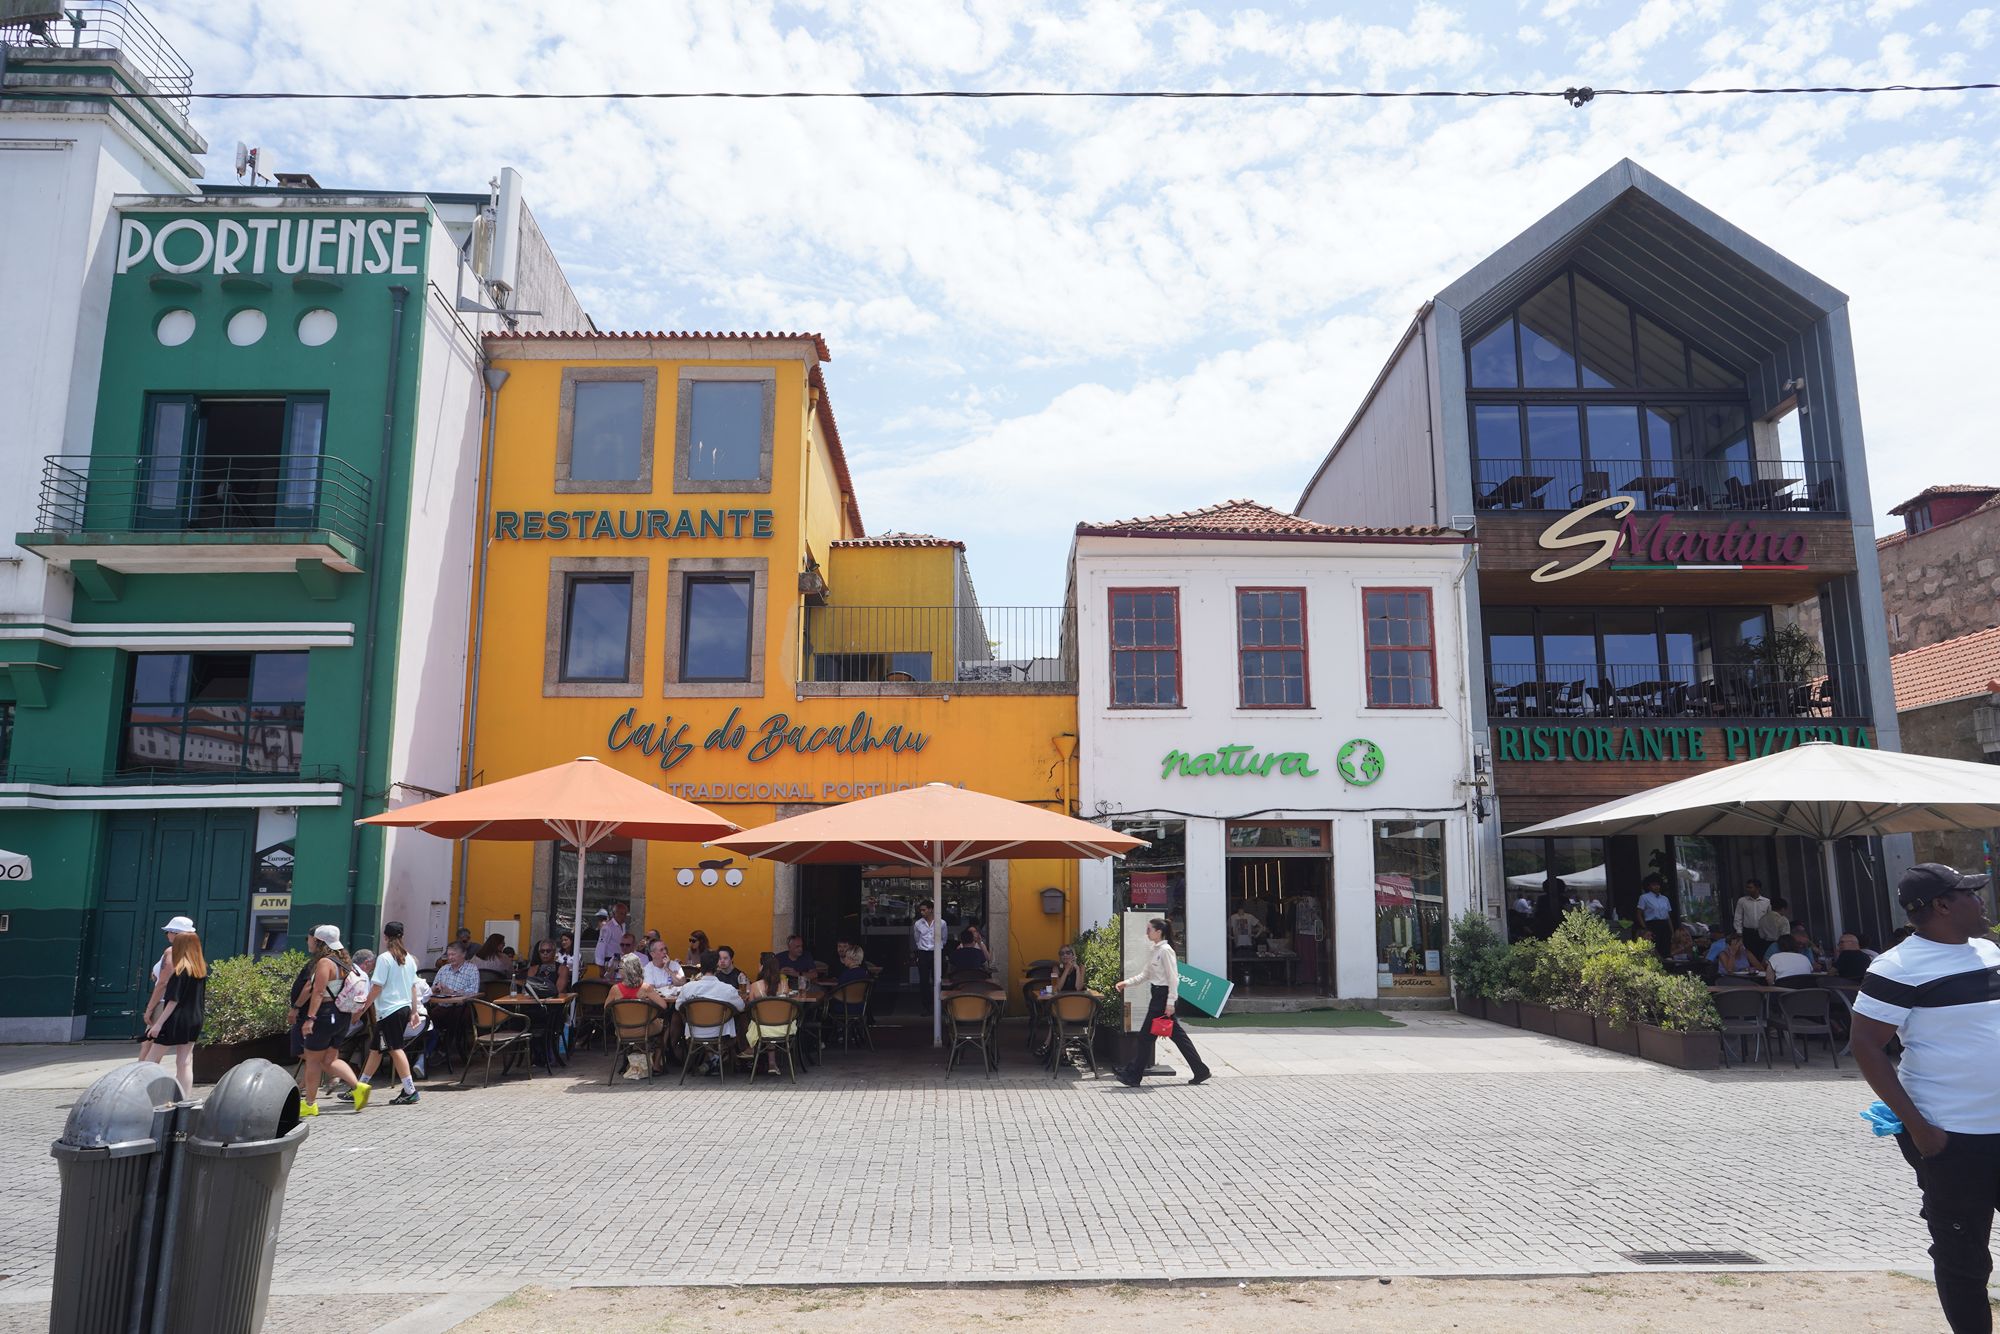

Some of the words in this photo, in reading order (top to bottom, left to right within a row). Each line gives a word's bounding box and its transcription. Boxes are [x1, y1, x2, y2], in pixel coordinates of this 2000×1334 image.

[116, 219, 421, 275] PORTUENSE
[495, 509, 774, 540] RESTAURANTE
[1611, 513, 1809, 563] Martino
[607, 706, 695, 770] Cais
[703, 706, 747, 751] do
[747, 711, 930, 763] Bacalhau
[1498, 726, 1706, 762] RISTORANTE
[1161, 743, 1319, 780] natura
[669, 783, 815, 799] TRADICIONAL
[260, 899, 287, 907] ATM
[1393, 978, 1436, 987] natura
